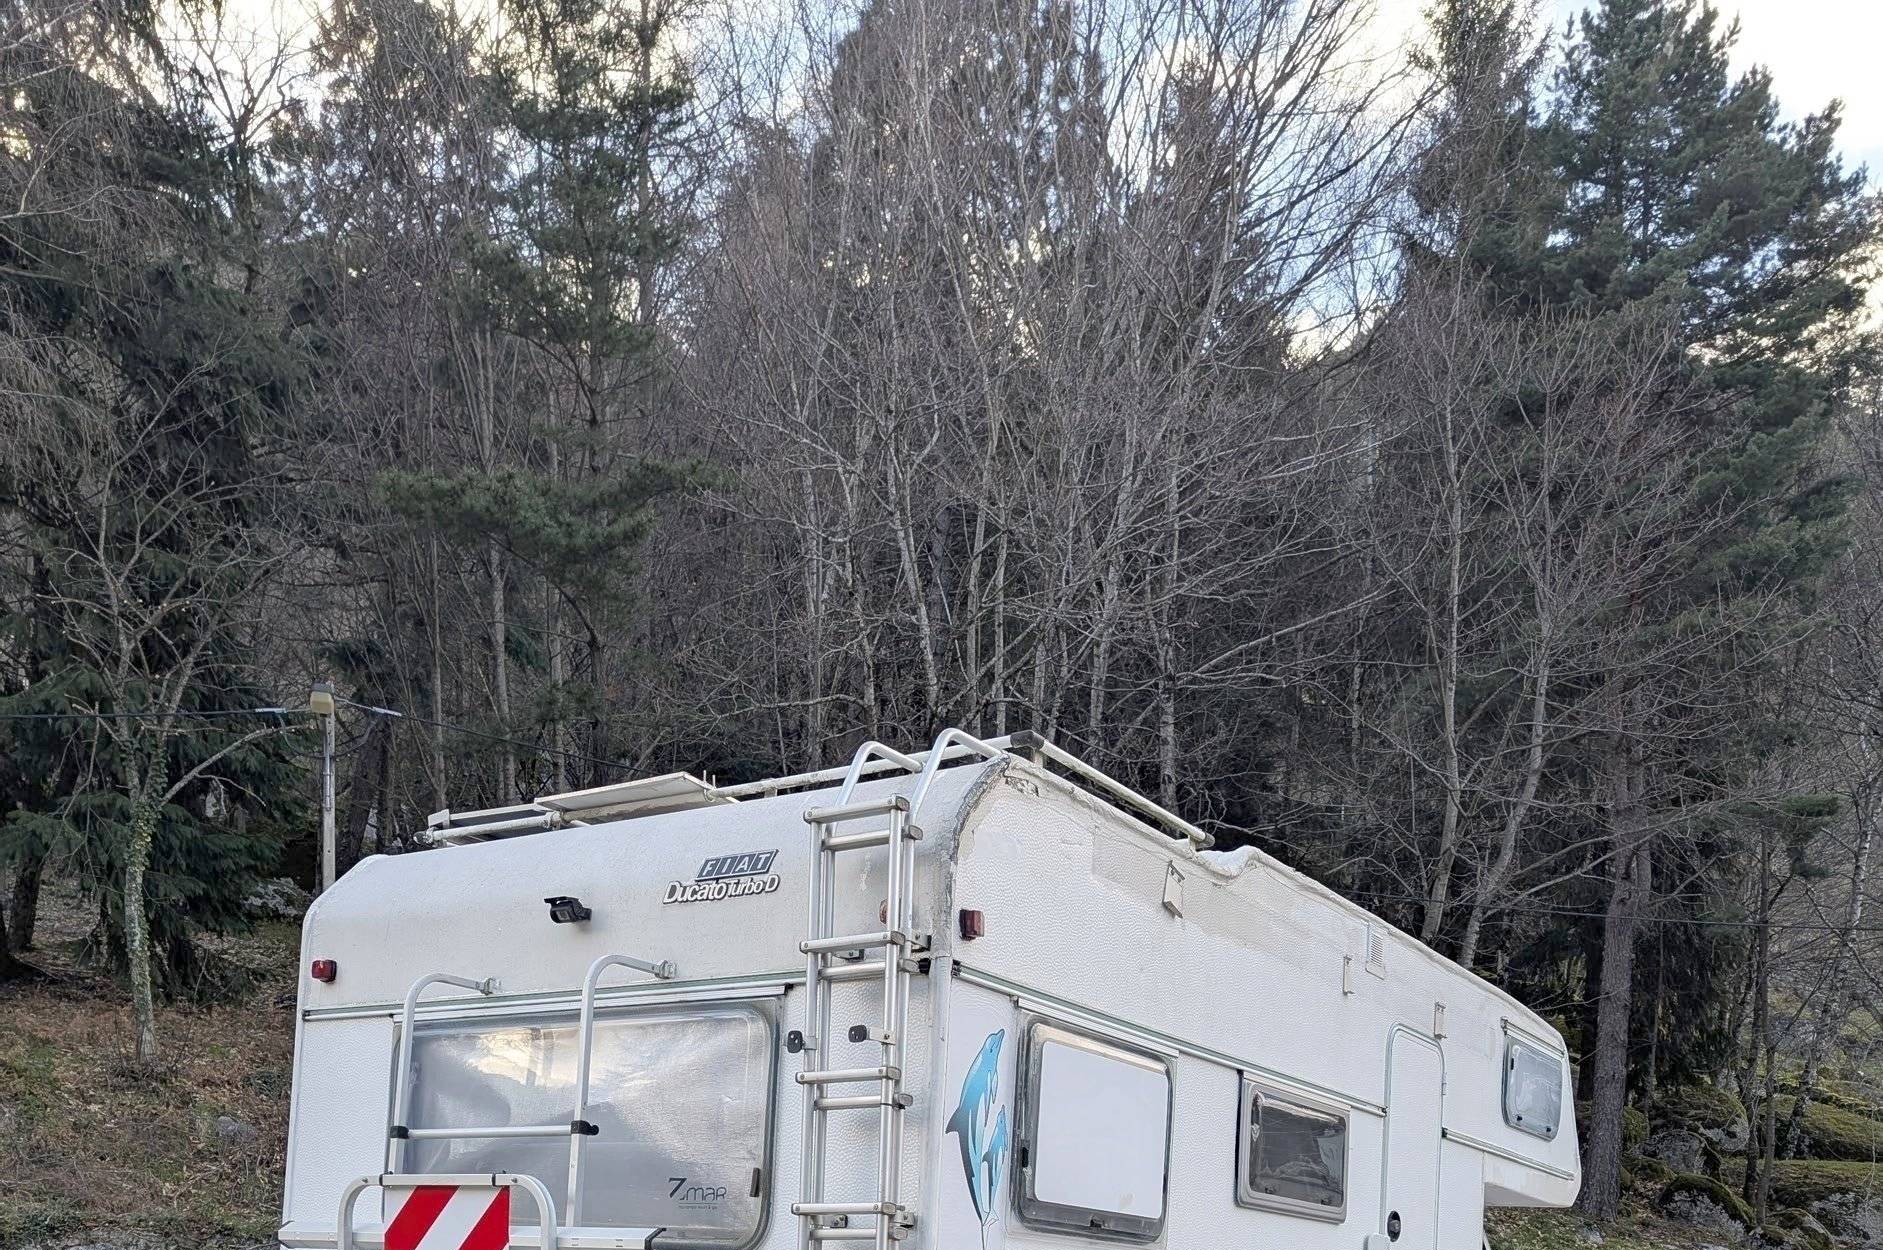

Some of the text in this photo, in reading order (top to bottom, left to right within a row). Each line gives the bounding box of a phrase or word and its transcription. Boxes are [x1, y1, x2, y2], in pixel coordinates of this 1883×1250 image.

[701, 853, 771, 876] FIAT
[663, 874, 781, 904] Ducato Turbo D
